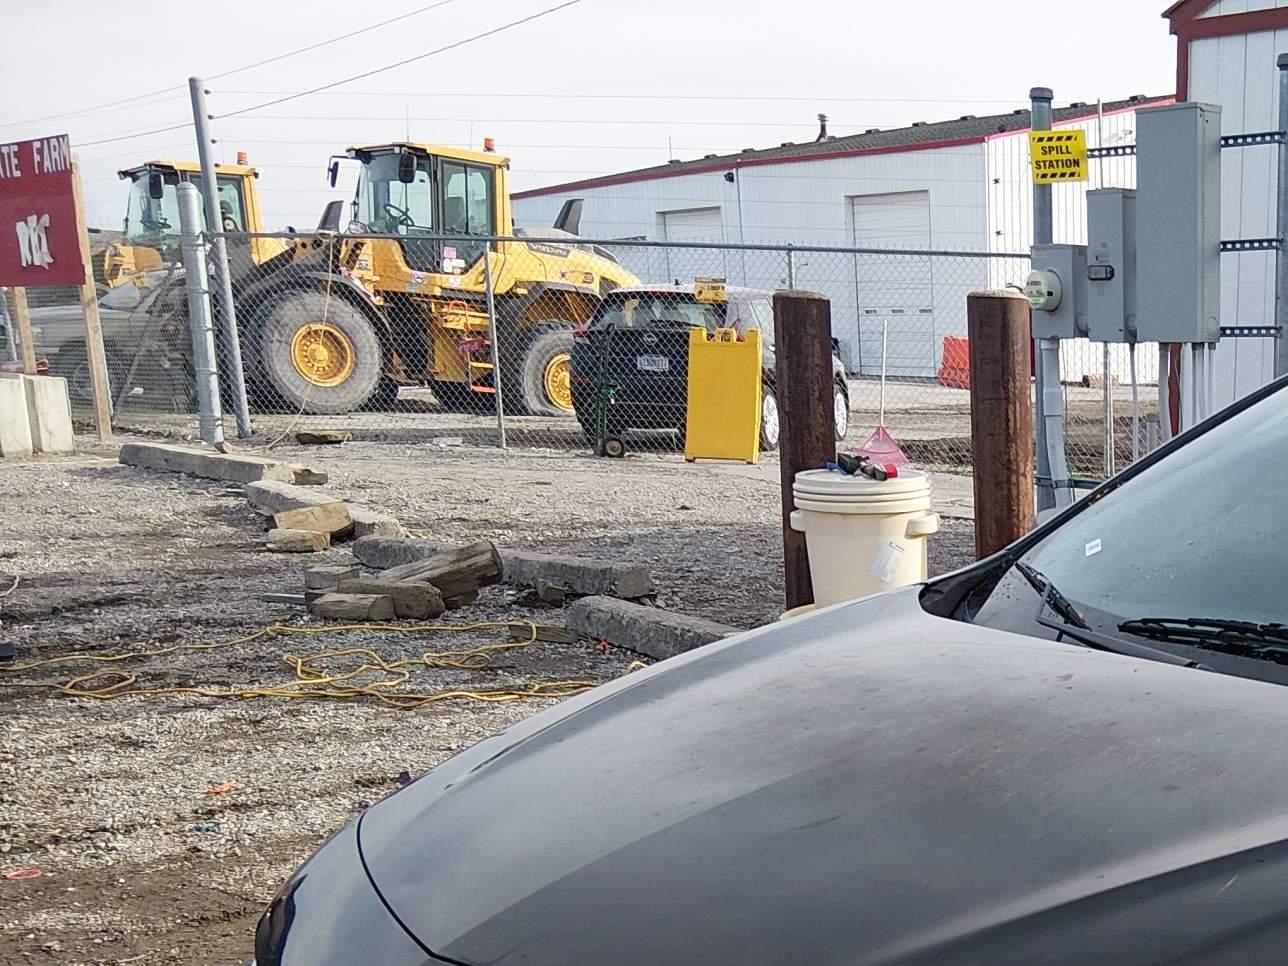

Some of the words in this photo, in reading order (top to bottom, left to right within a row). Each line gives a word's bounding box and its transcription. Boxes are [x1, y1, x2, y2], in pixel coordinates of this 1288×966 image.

[32, 135, 70, 174] FARM
[1040, 145, 1072, 156] SPILL
[1034, 158, 1080, 170] STATION
